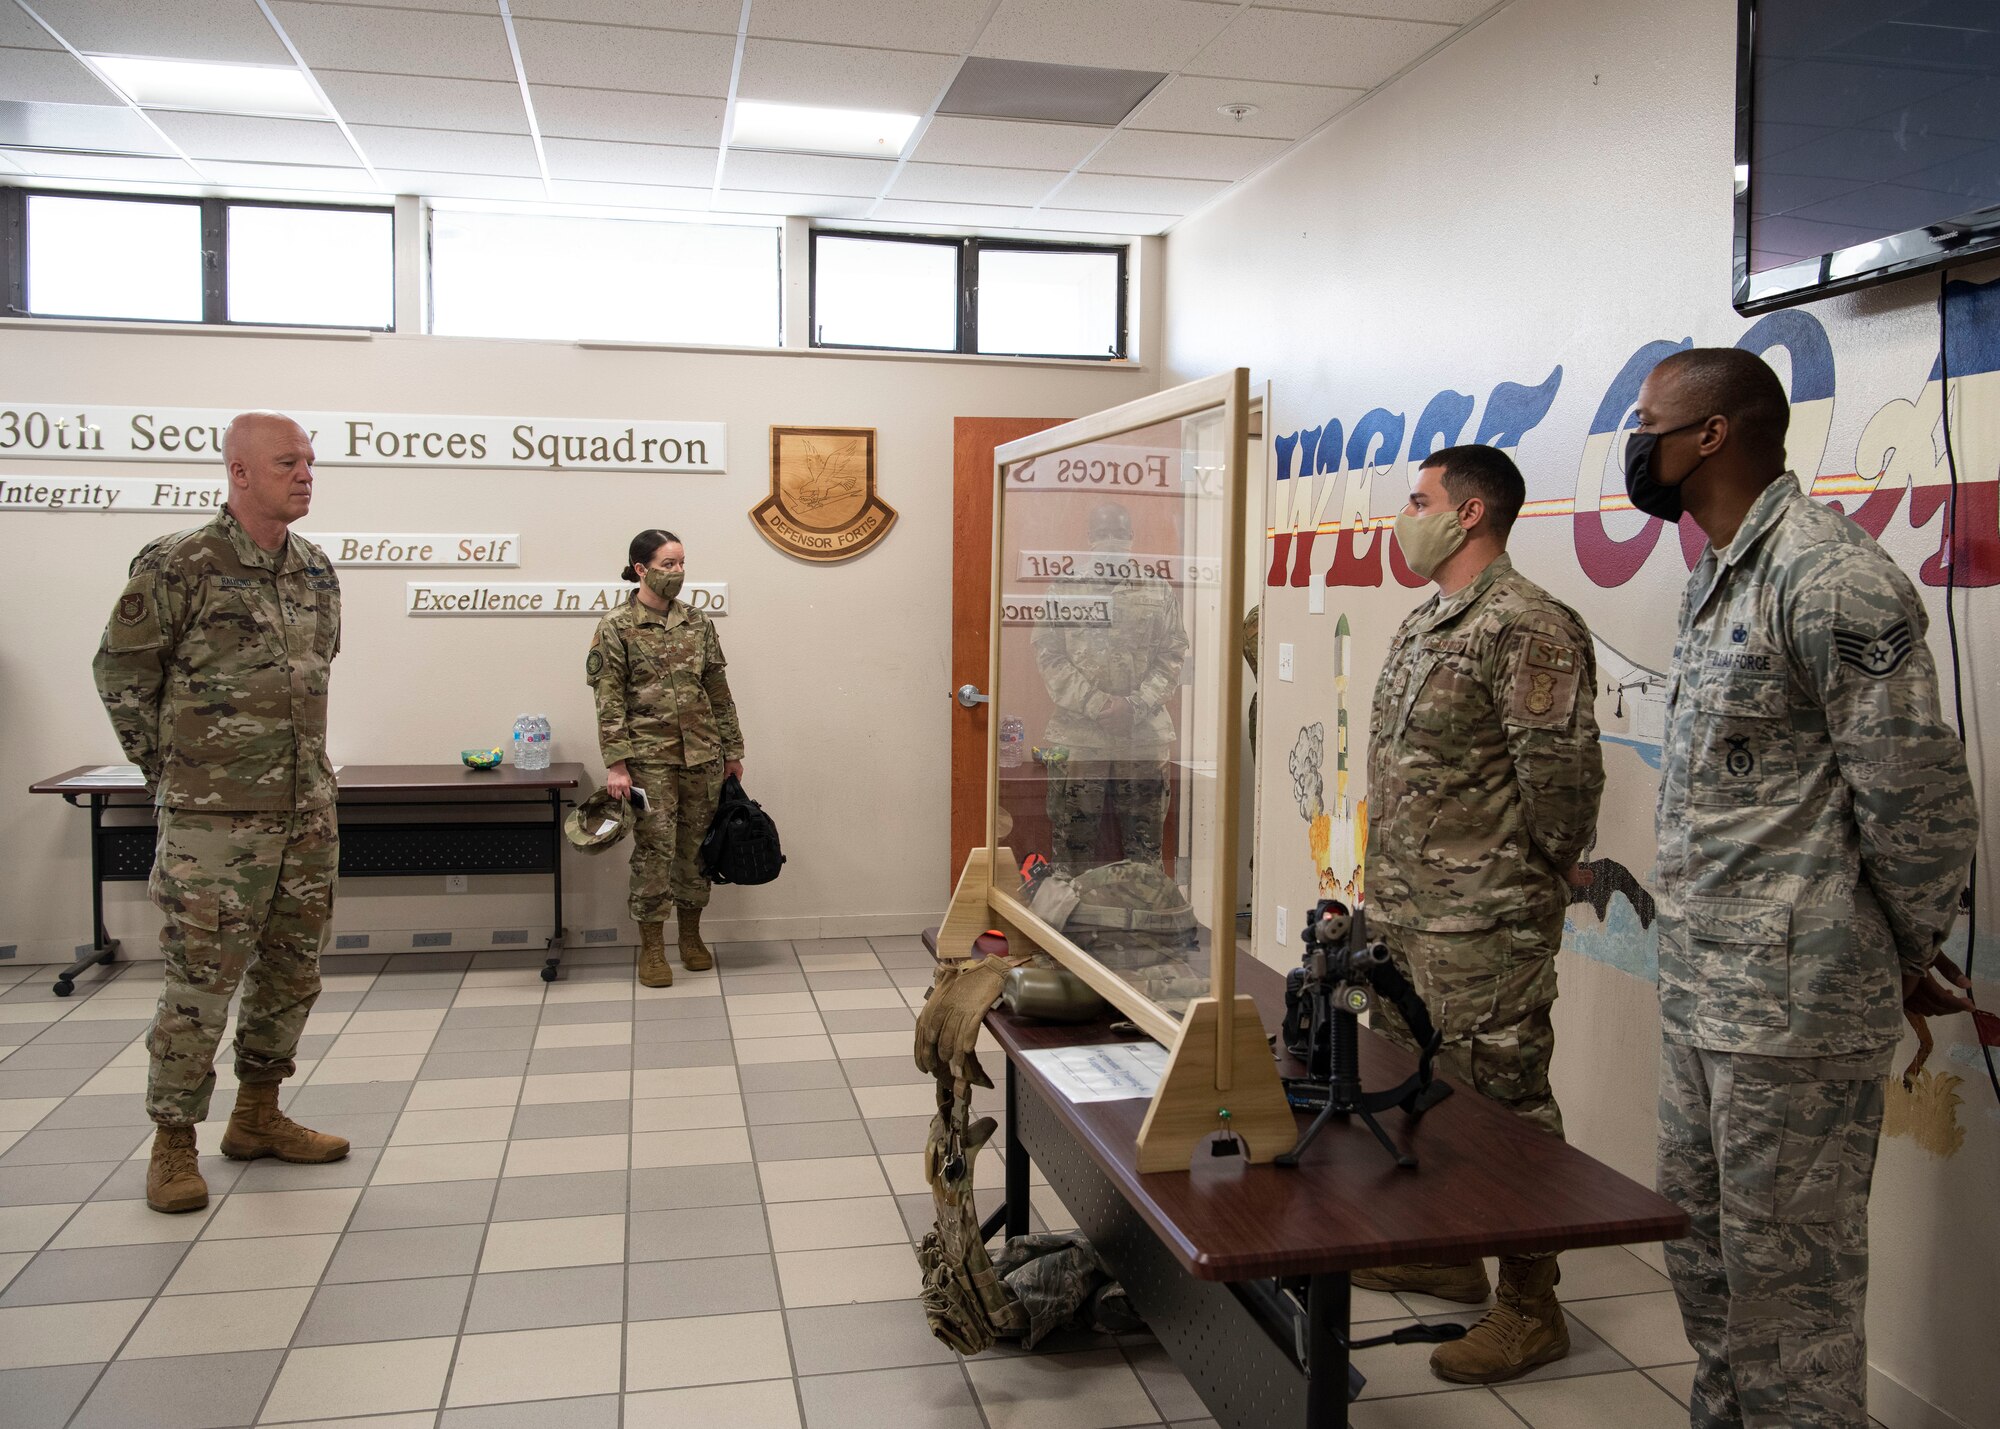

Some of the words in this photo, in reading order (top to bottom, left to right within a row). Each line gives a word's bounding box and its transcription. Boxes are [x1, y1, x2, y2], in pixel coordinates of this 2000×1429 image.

[1928, 230, 1958, 243] Panasonic
[0, 411, 104, 450] 30th
[345, 421, 487, 459] Forces
[512, 424, 709, 467] Squadron
[0, 481, 121, 509] Integrity
[152, 484, 222, 507] First
[770, 515, 832, 548] DEFENSOR
[837, 516, 877, 546] FORTIS
[339, 539, 433, 561] Before
[457, 539, 511, 562] Self
[410, 588, 543, 611] Excellence
[554, 588, 581, 611] In
[589, 588, 632, 611] All
[691, 589, 725, 610] Do
[1734, 654, 1771, 671] FORCE
